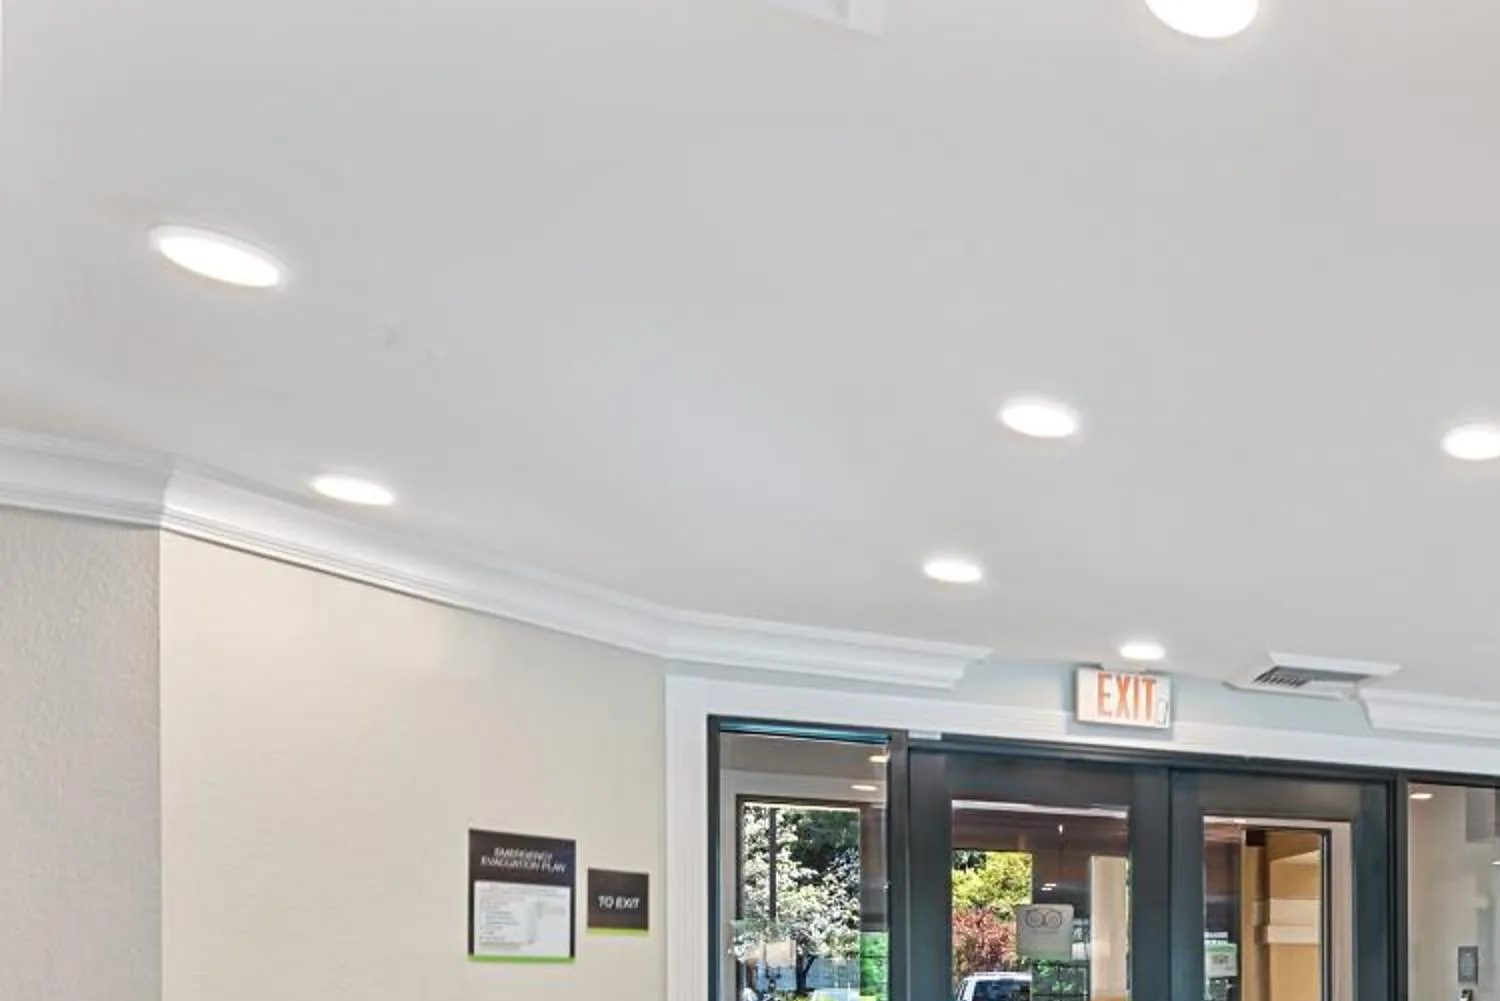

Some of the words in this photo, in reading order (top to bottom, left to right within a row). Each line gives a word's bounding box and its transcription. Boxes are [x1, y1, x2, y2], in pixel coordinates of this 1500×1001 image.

[1098, 671, 1157, 721] EXIT
[493, 847, 553, 860] EMERGENCY
[481, 855, 540, 872] EVACUATION
[541, 864, 567, 873] PLAN
[598, 895, 614, 909] TO
[615, 896, 640, 909] EXIT
